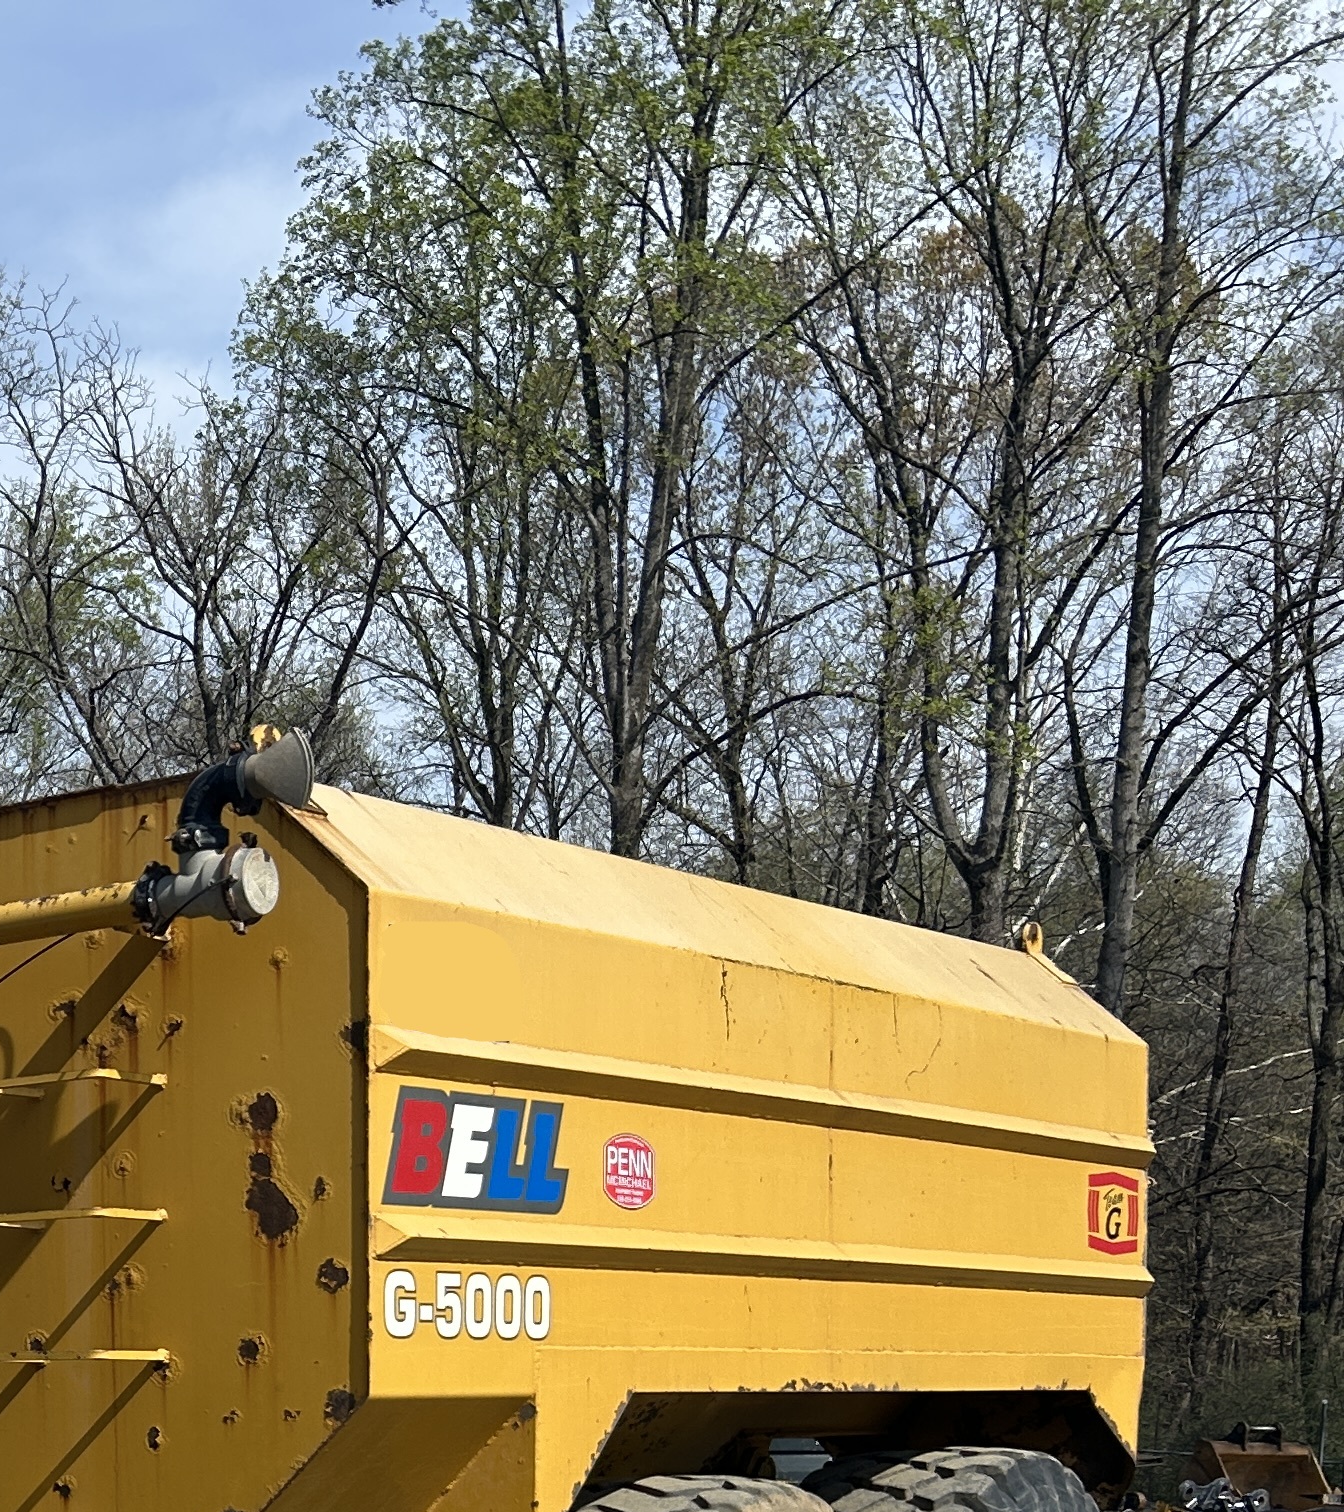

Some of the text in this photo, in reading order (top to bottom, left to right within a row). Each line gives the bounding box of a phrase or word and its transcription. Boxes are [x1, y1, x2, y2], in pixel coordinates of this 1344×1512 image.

[386, 1091, 568, 1208] BELL
[607, 1145, 652, 1178] PENN
[1105, 1207, 1121, 1240] G
[383, 1270, 552, 1340] G-5000
